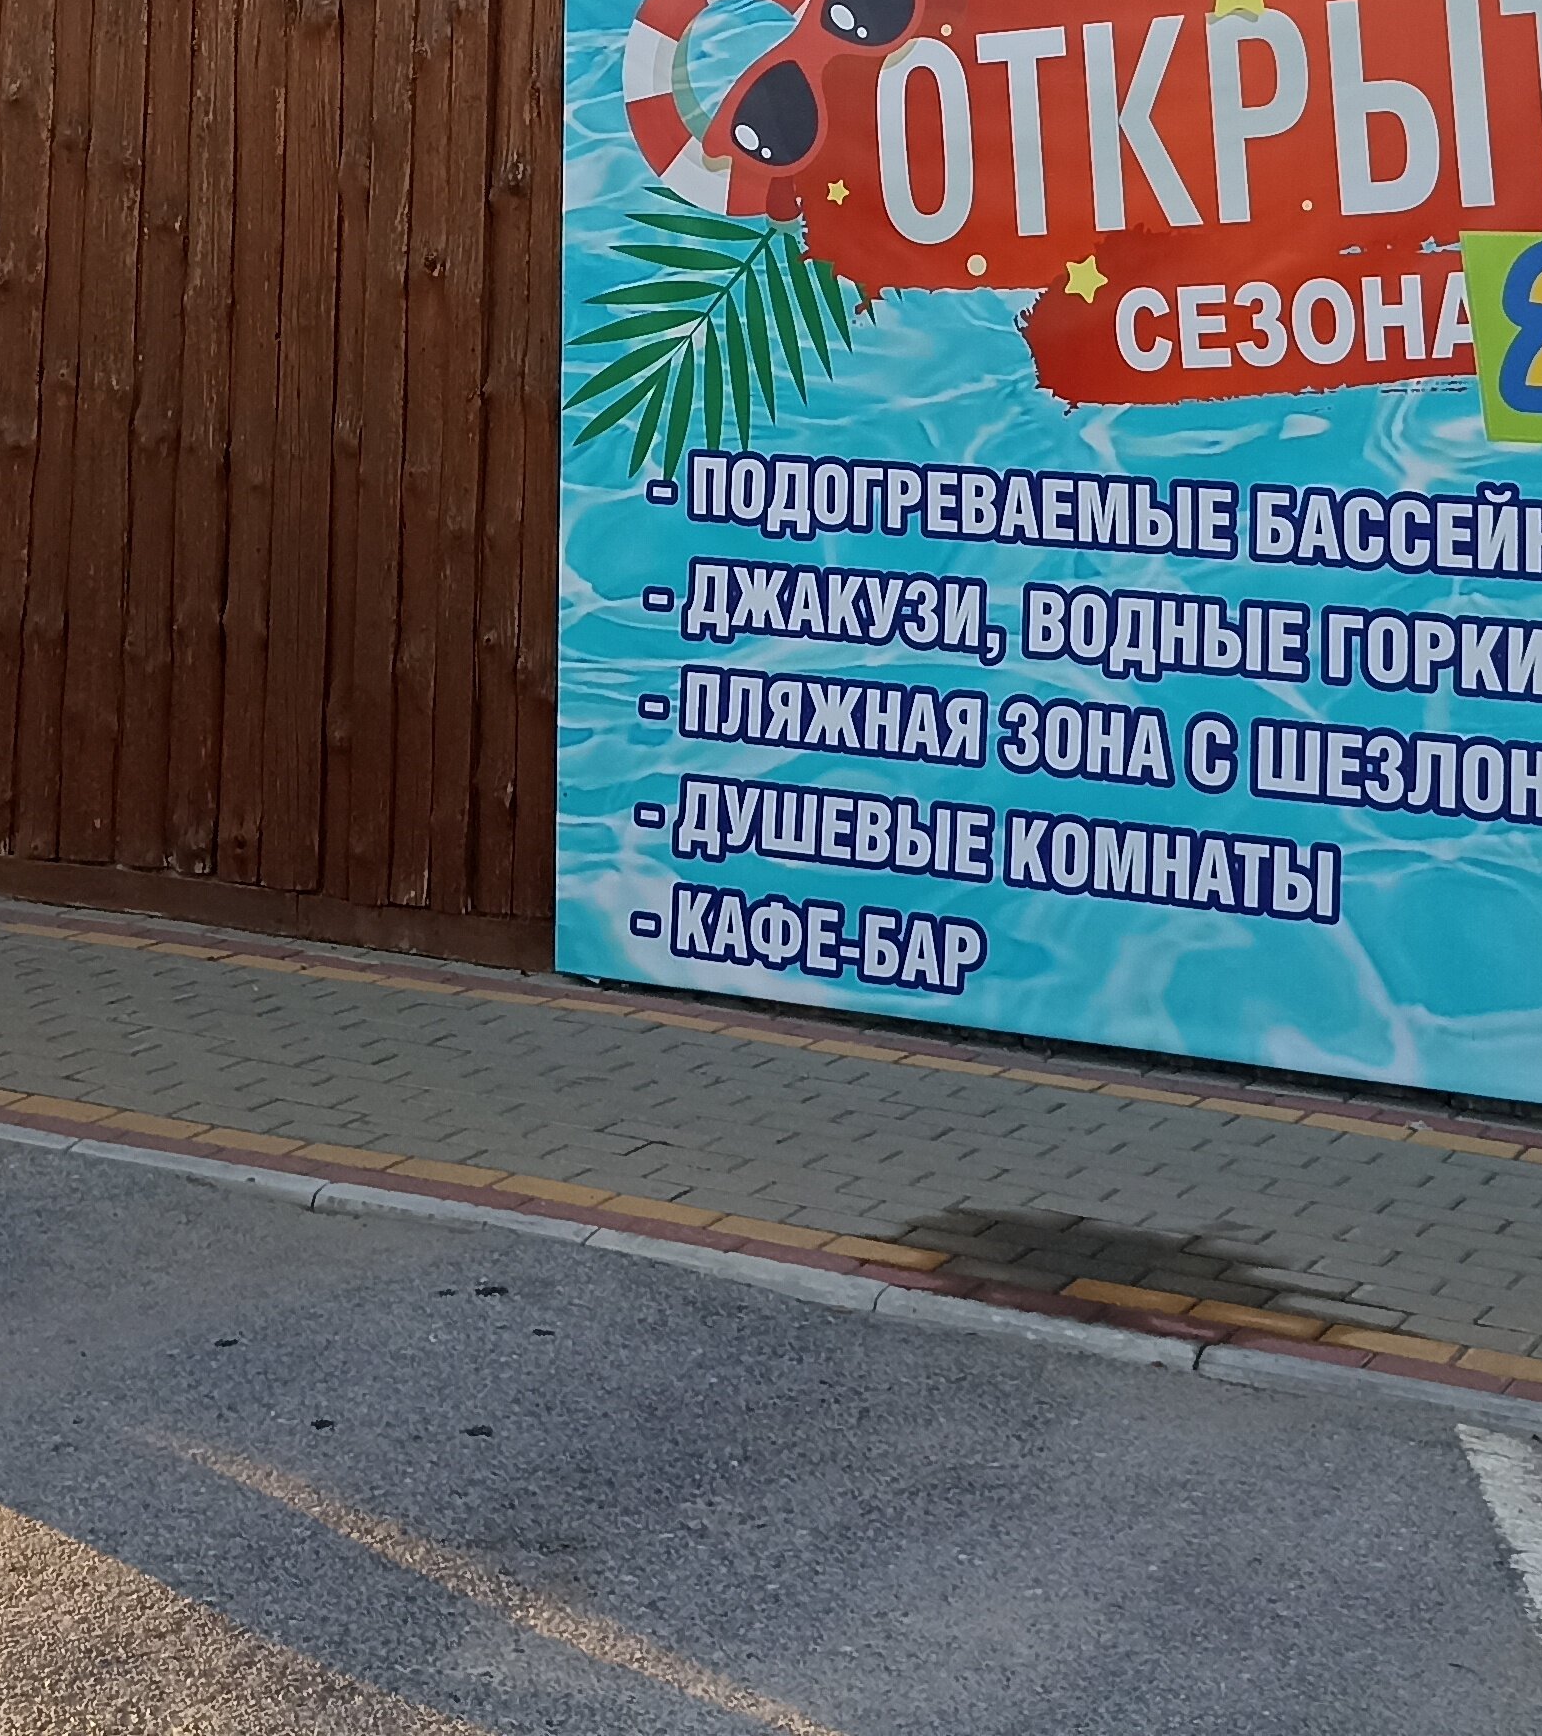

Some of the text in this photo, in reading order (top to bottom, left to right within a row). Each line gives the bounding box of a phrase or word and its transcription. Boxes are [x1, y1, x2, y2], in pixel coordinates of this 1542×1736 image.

[1114, 270, 1475, 372] СЕЗОНА
[690, 453, 1236, 555] ПОДОГРЕВАЕМЫЕ
[686, 562, 1002, 658] ДЖАКУЗИ,
[1027, 588, 1304, 676] ВОДНЫЕ
[684, 670, 983, 762] ПЛЯЖНАЯ
[1002, 700, 1170, 782] ЗОНА
[1191, 718, 1236, 788] С
[678, 780, 991, 878] ДУШЕВЫЕ
[1009, 816, 1335, 919] КОМНАТЫ
[676, 888, 983, 989] КАФЕ-БАР
